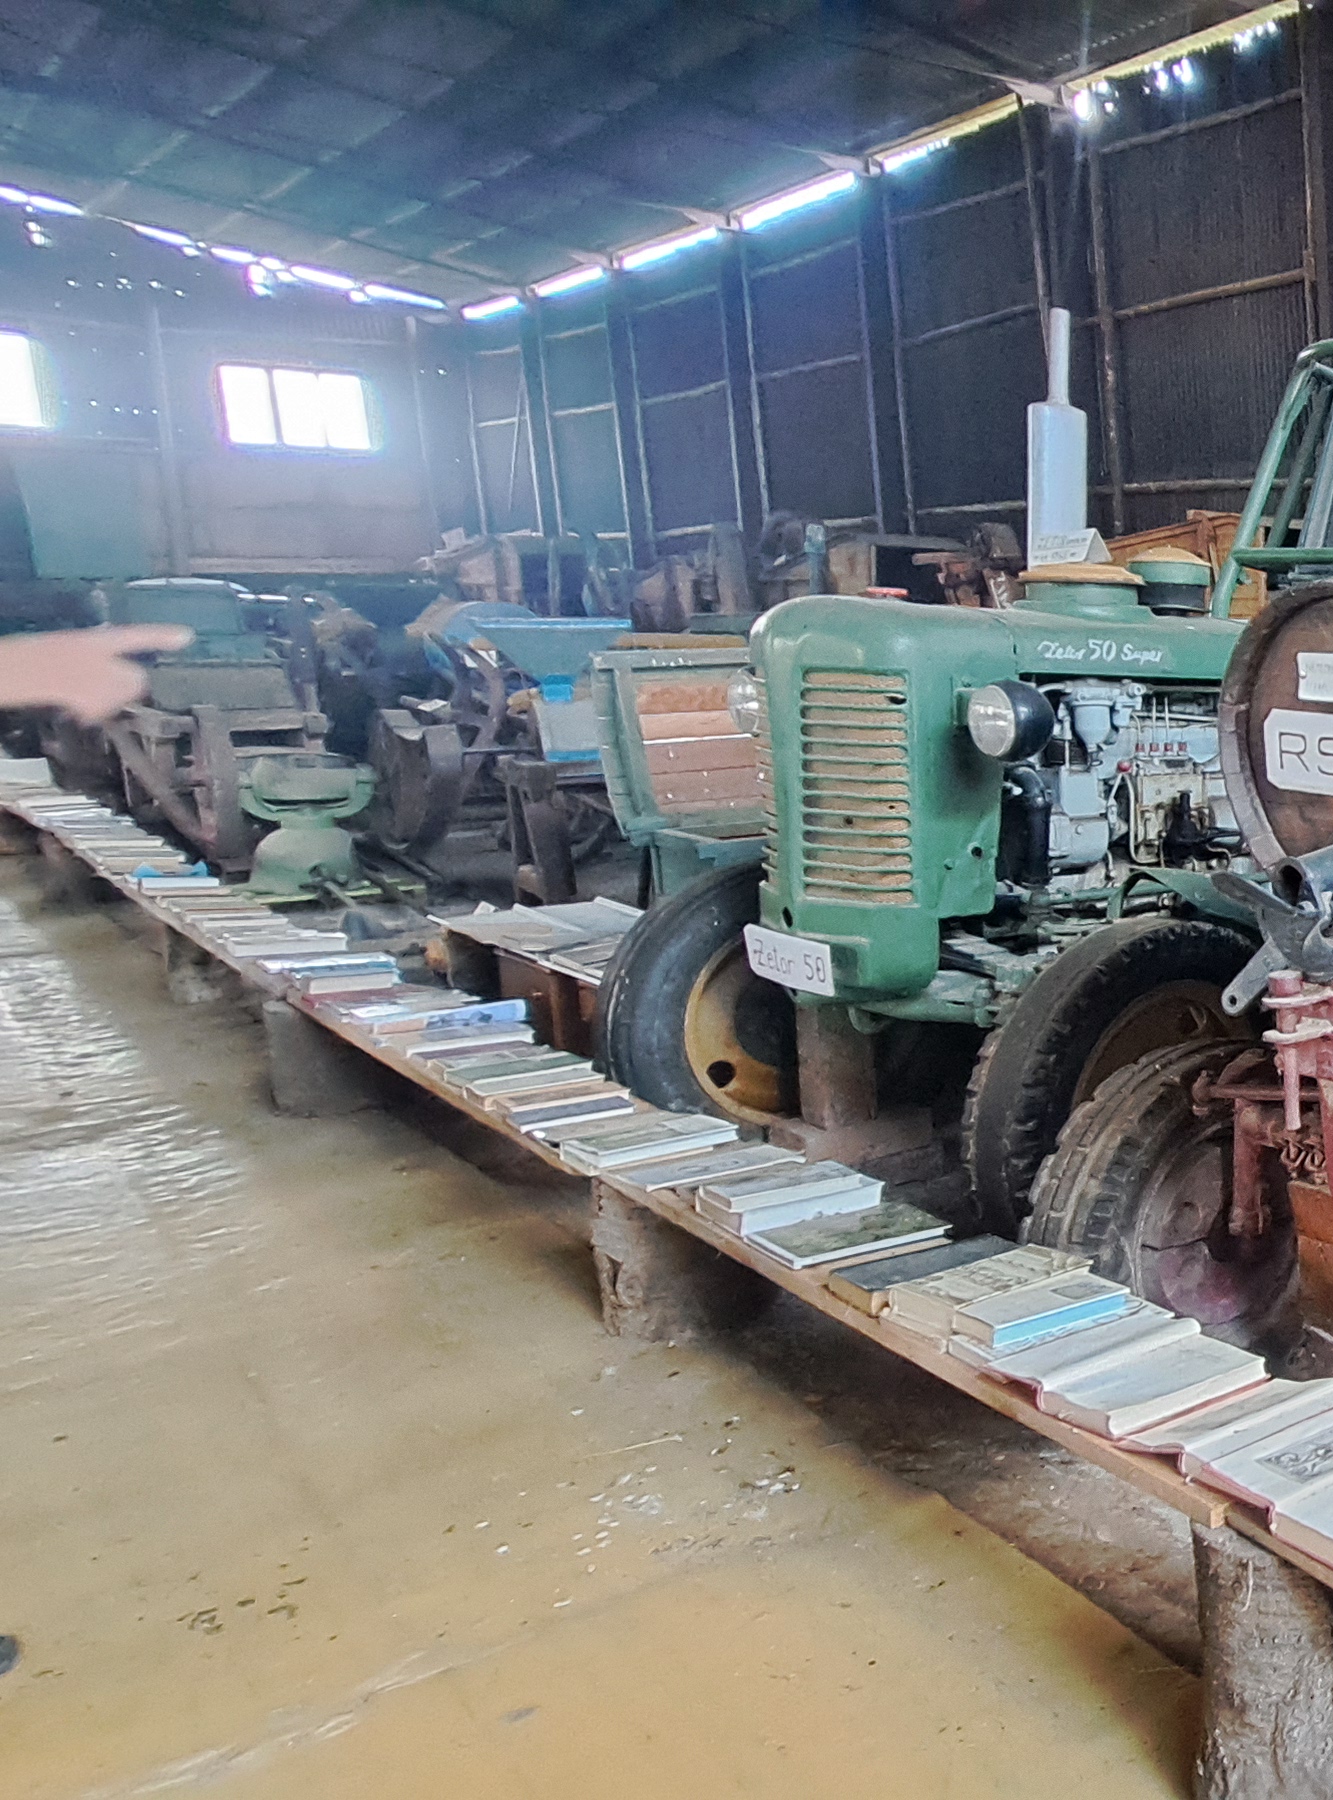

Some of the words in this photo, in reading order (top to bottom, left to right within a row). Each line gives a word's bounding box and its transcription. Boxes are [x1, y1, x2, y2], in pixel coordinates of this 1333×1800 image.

[1088, 639, 1117, 662] 50
[1121, 643, 1163, 666] Super
[753, 938, 796, 975] Zetor
[803, 953, 827, 984] 50
